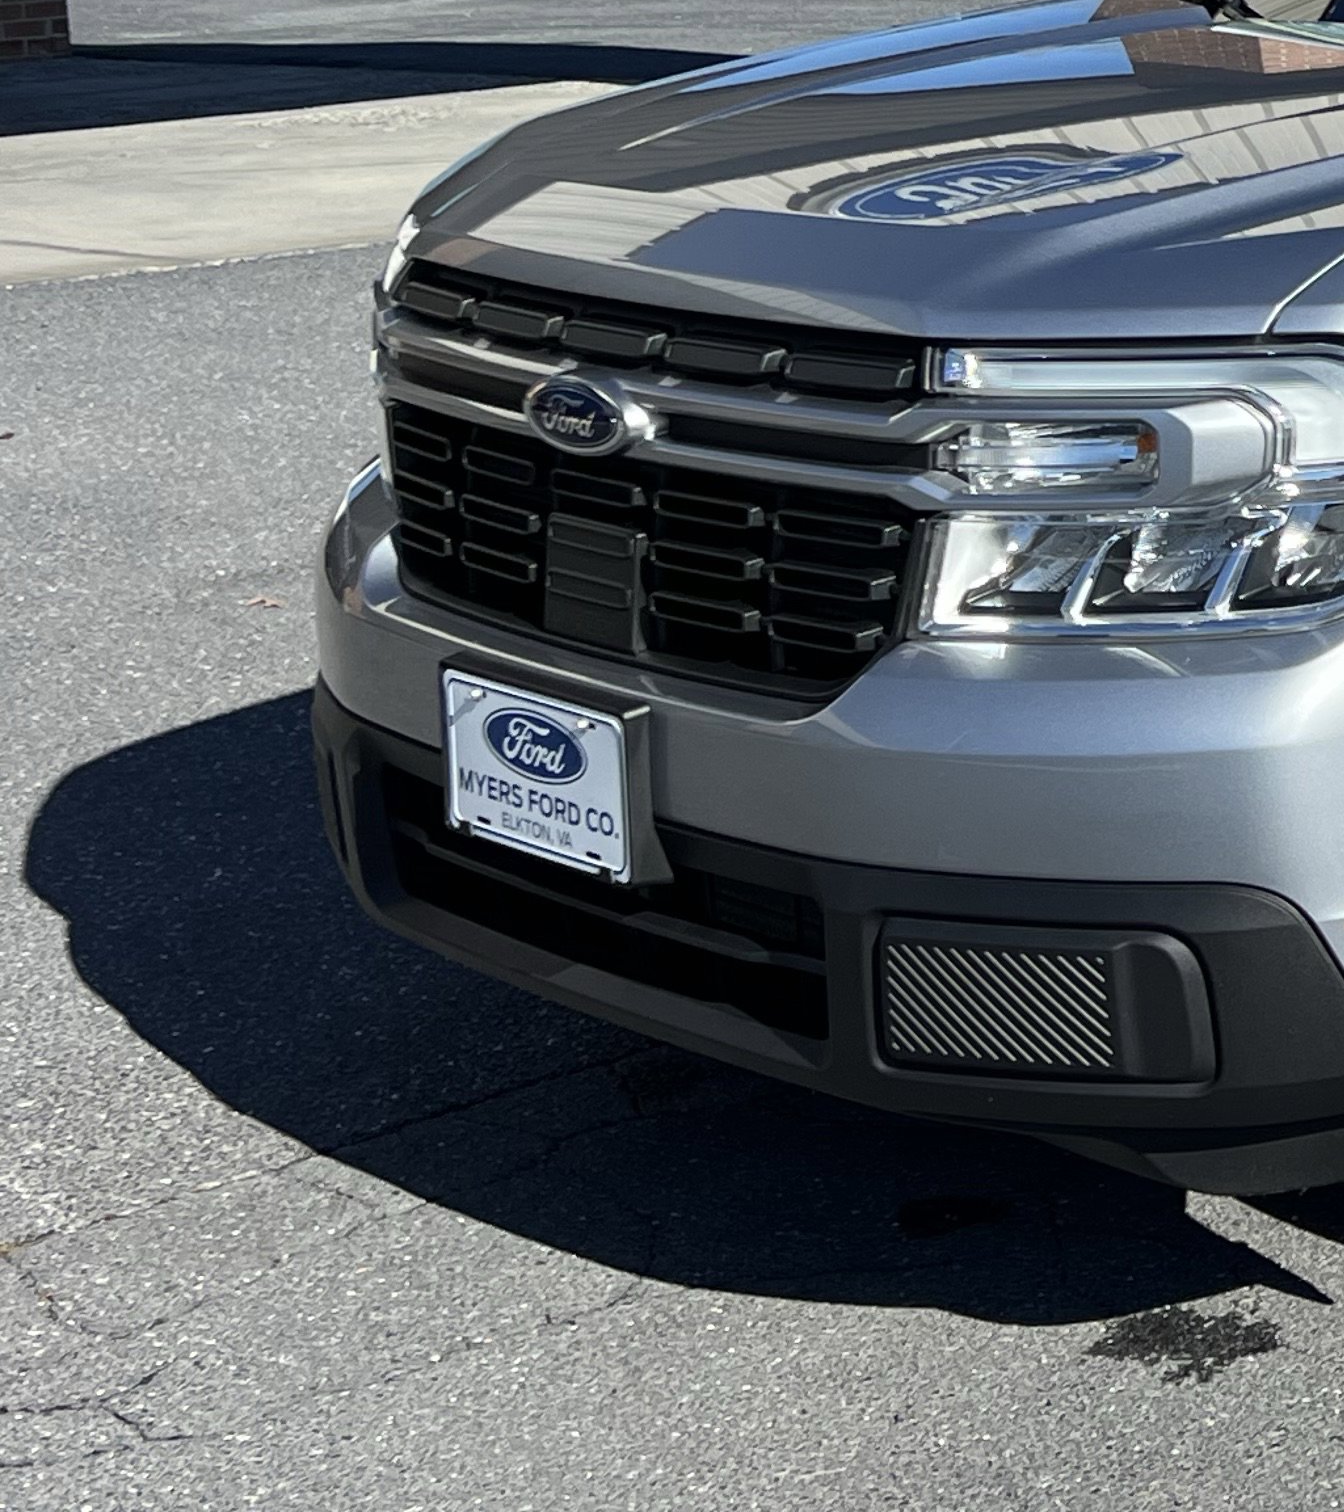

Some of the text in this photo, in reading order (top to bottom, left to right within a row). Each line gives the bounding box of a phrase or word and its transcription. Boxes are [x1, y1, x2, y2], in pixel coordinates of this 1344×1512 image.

[540, 393, 597, 439] Ford
[502, 716, 567, 775] Ford
[459, 767, 620, 839] MYERS FORD CO.
[501, 812, 574, 849] ELKTON, VA
